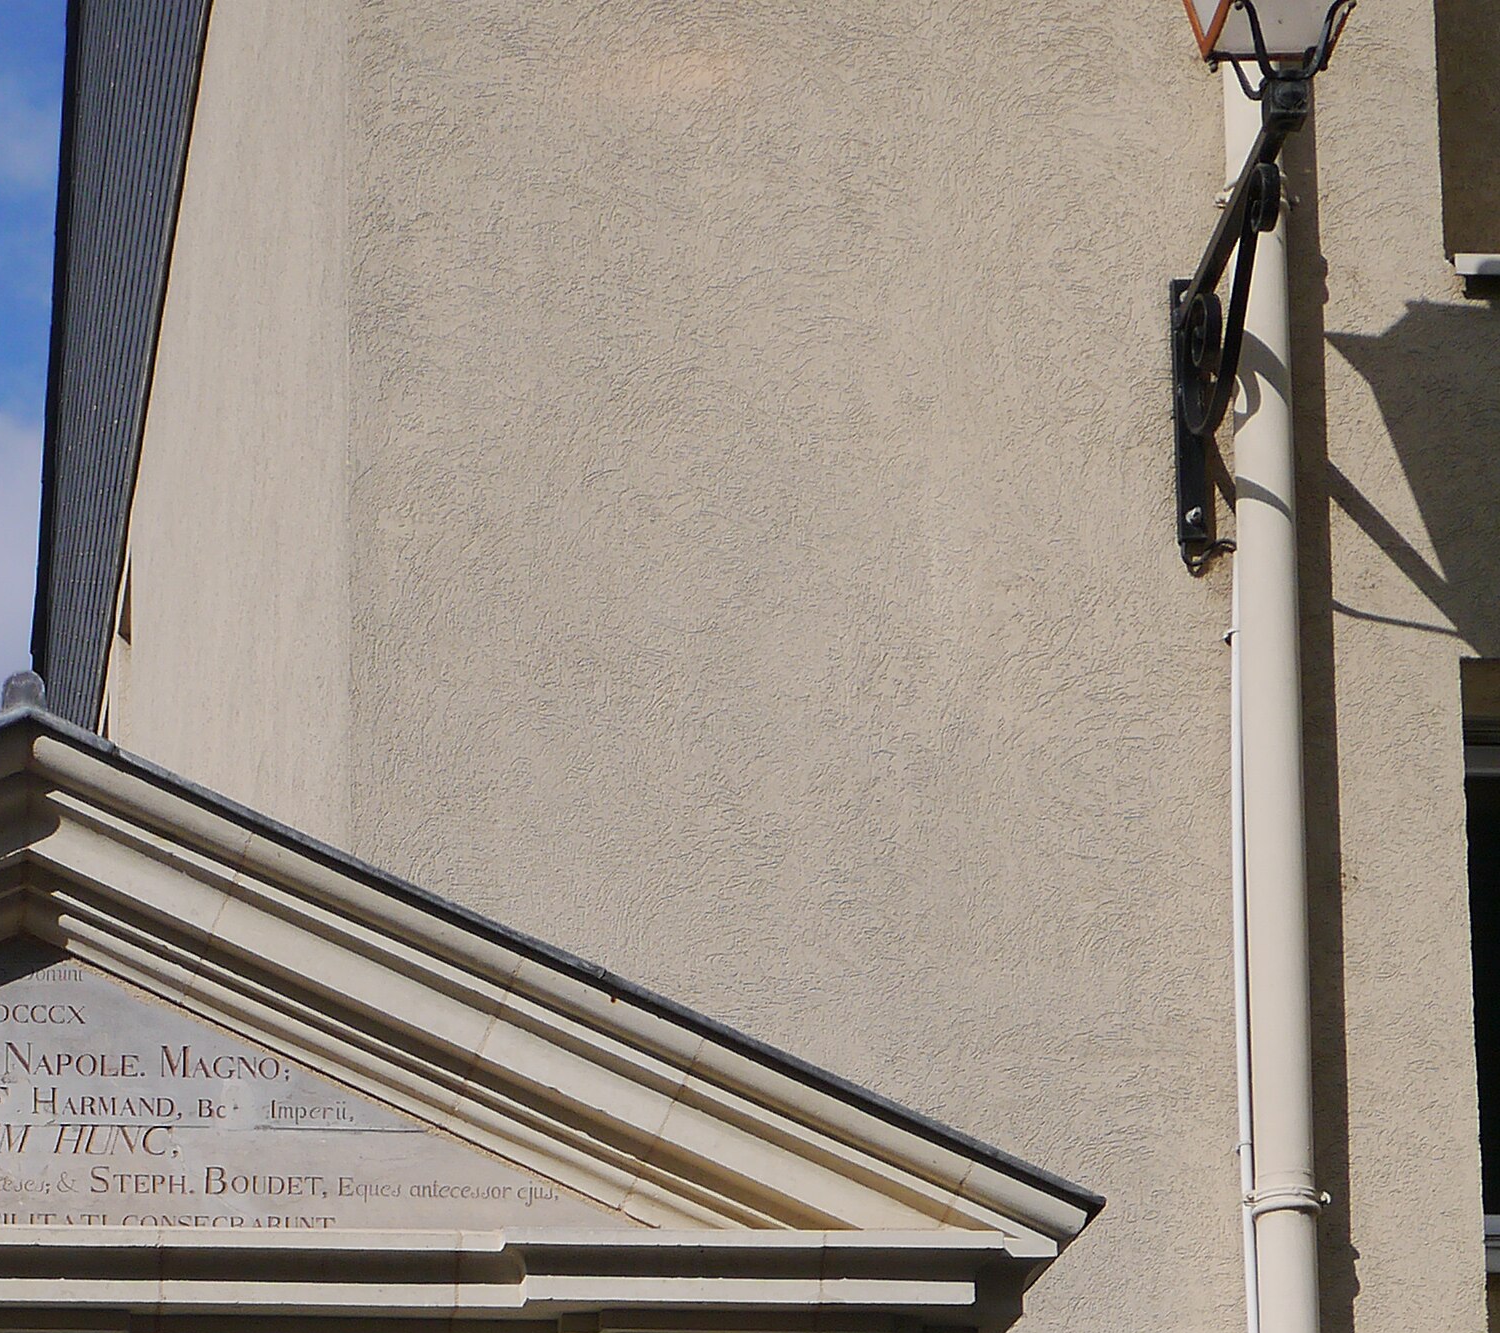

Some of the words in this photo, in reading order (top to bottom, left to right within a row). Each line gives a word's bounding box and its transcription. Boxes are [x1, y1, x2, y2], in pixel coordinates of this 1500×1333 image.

[52, 1124, 181, 1158] HUNC,
[56, 1171, 79, 1193] &
[337, 1176, 401, 1203] Eques
